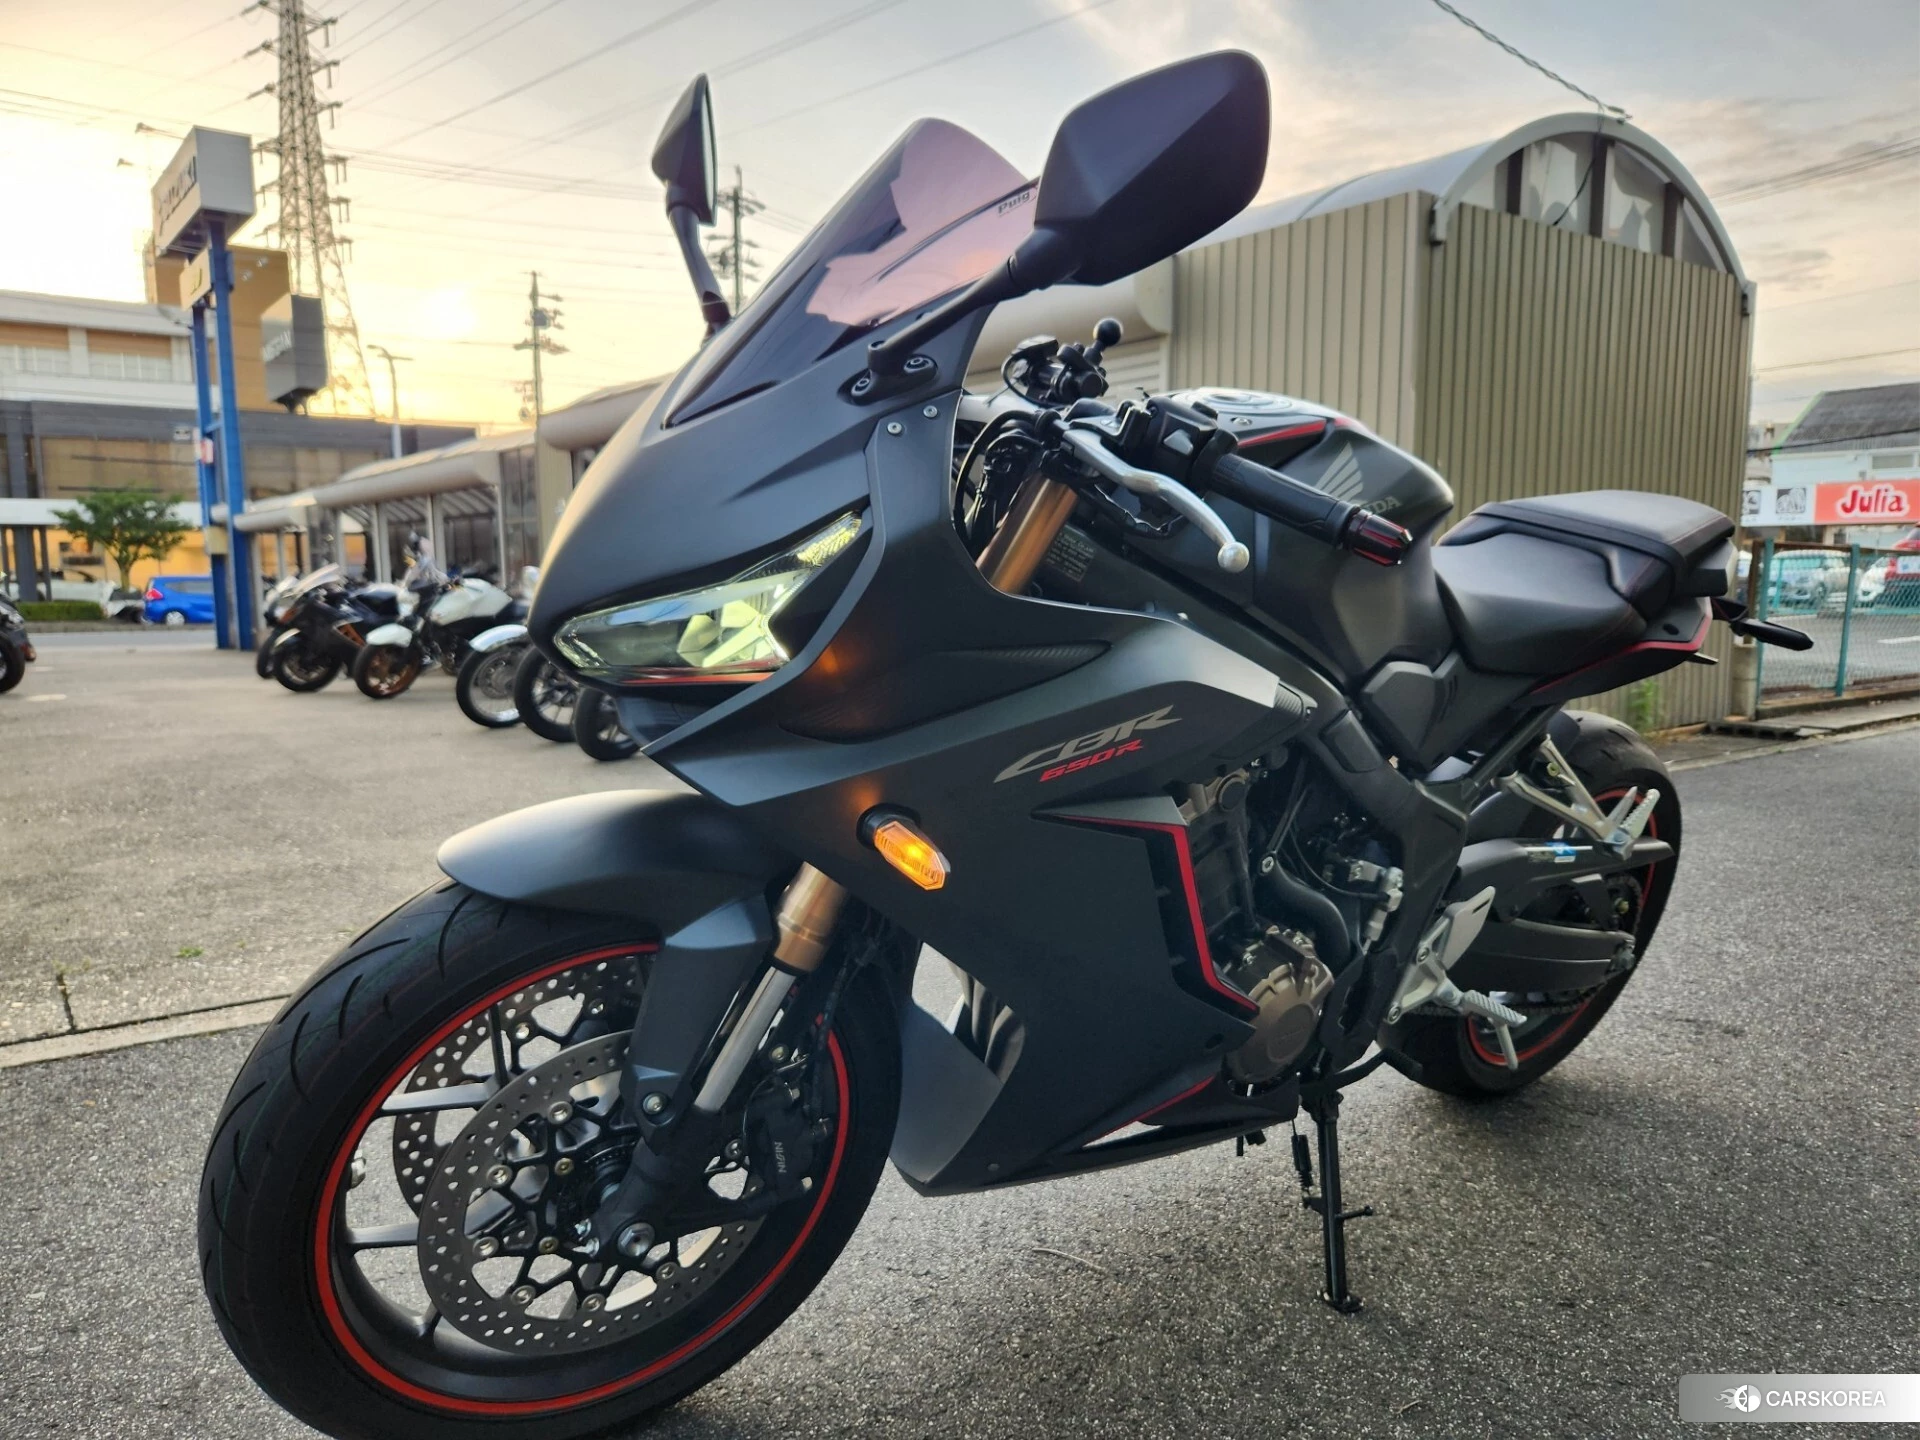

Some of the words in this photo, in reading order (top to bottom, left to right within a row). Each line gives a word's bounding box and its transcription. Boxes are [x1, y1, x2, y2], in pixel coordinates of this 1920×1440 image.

[997, 191, 1030, 214] Puig
[1841, 488, 1904, 514] Julia
[993, 704, 1183, 784] CBR
[1039, 739, 1143, 782] 650R
[774, 1141, 787, 1173] NISSIN
